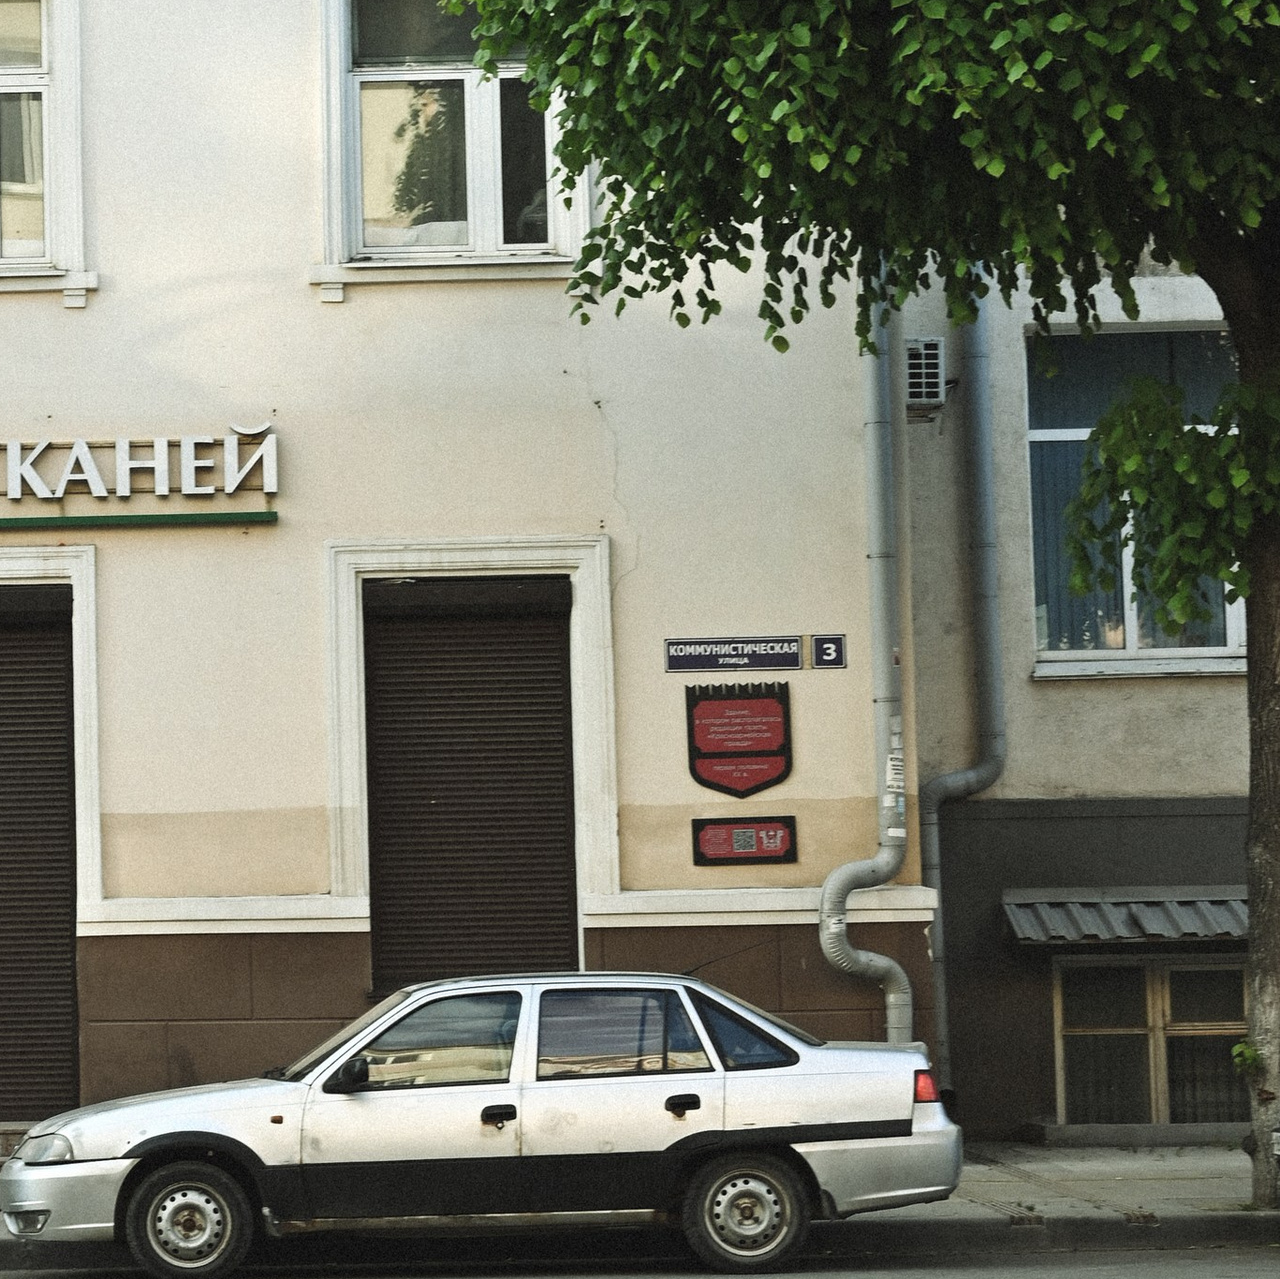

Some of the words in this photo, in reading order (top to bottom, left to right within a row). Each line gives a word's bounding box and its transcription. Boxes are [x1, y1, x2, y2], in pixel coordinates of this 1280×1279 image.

[669, 641, 798, 657] КОММУНИСТИЧЕСКАЯ
[822, 643, 837, 661] 3
[718, 656, 749, 665] УЛИЦА
